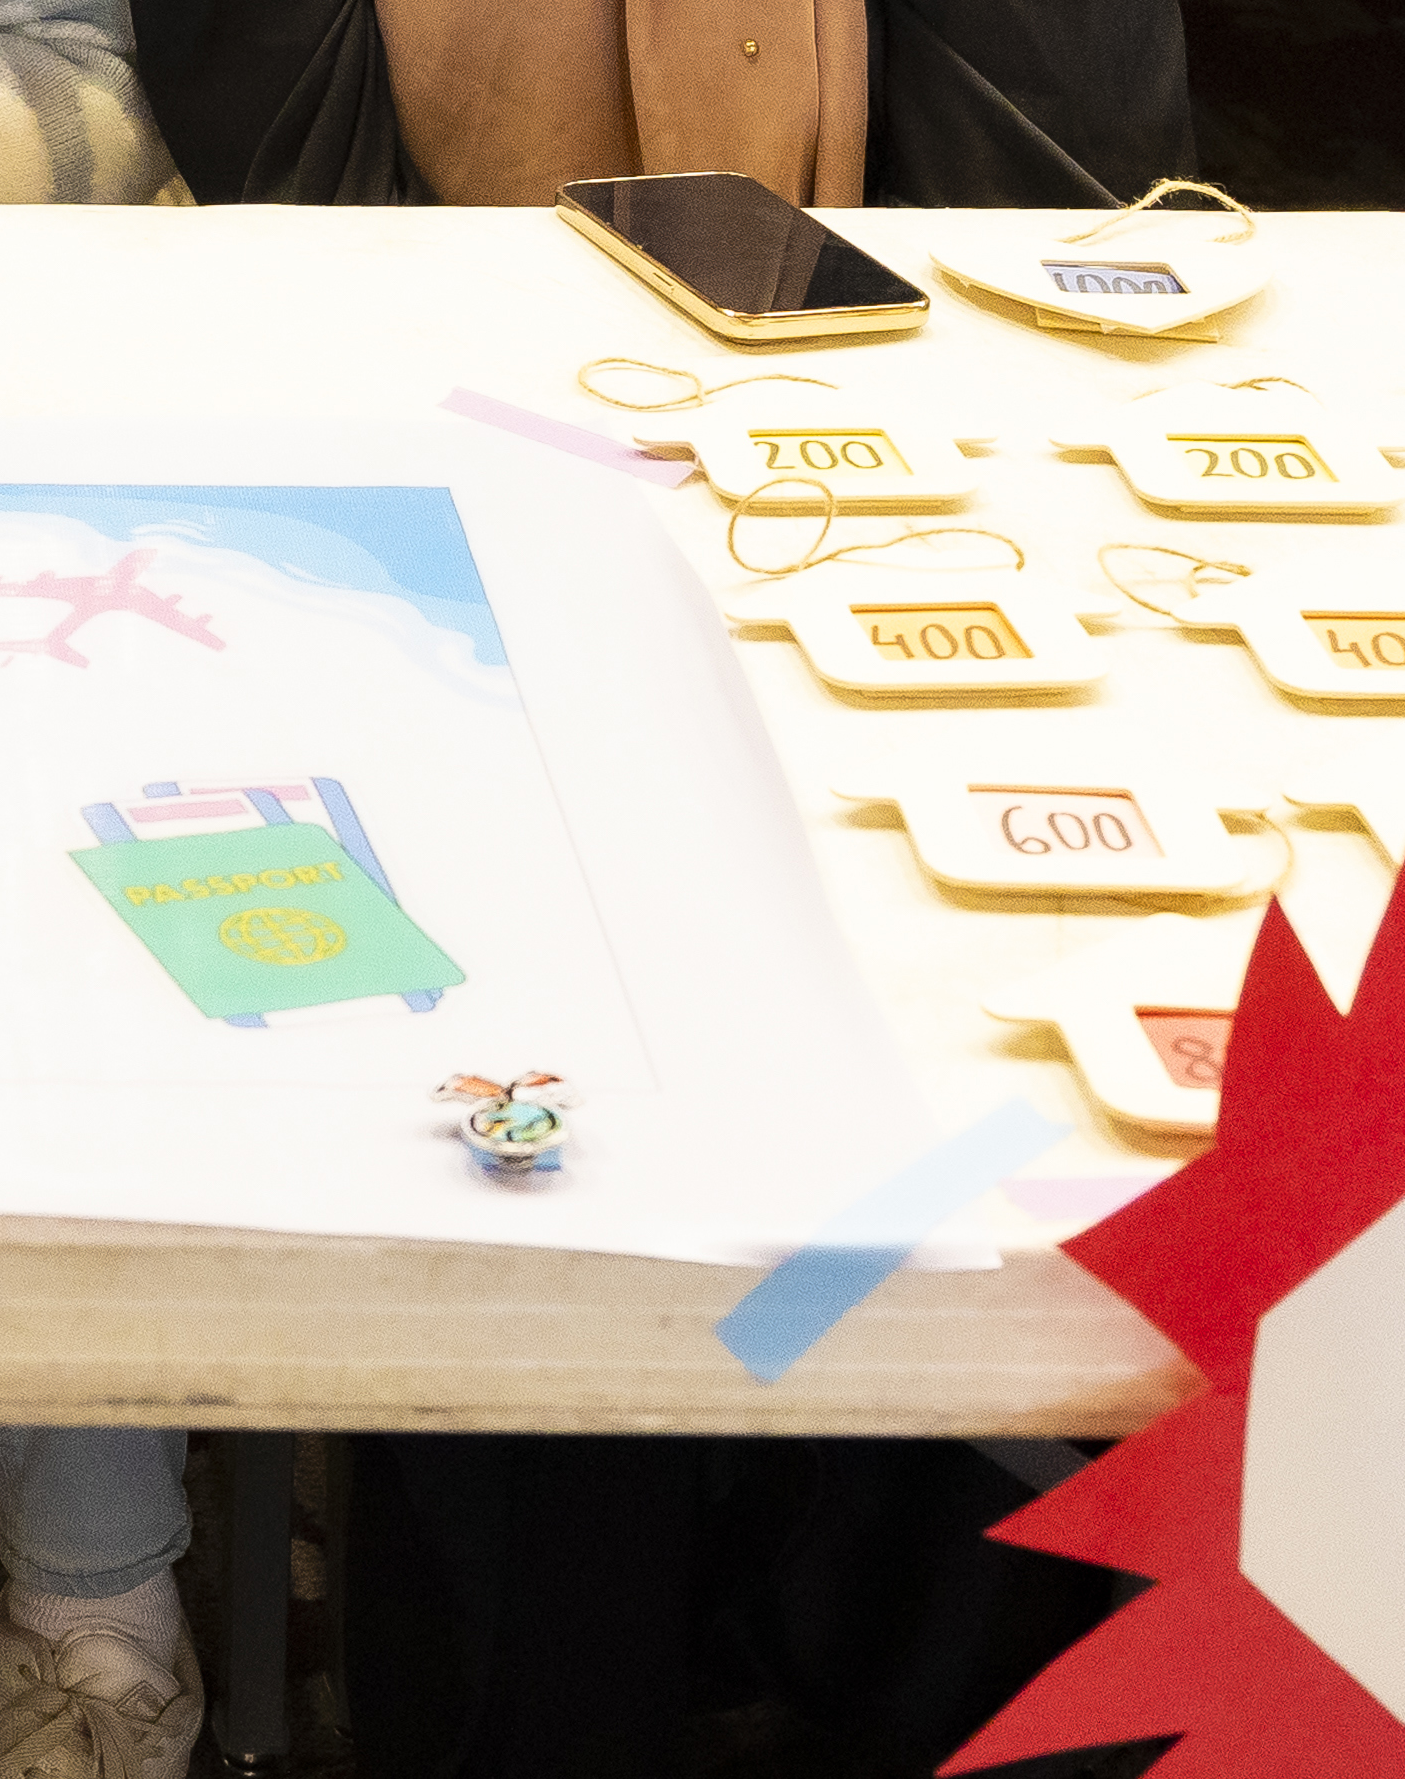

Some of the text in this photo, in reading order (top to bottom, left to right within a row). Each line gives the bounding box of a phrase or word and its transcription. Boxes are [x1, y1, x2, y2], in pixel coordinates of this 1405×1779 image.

[753, 440, 884, 471] 200
[1185, 447, 1317, 480] 200
[871, 623, 1007, 661] 400
[1000, 805, 1134, 855] 600
[124, 861, 344, 906] PASSPORT
